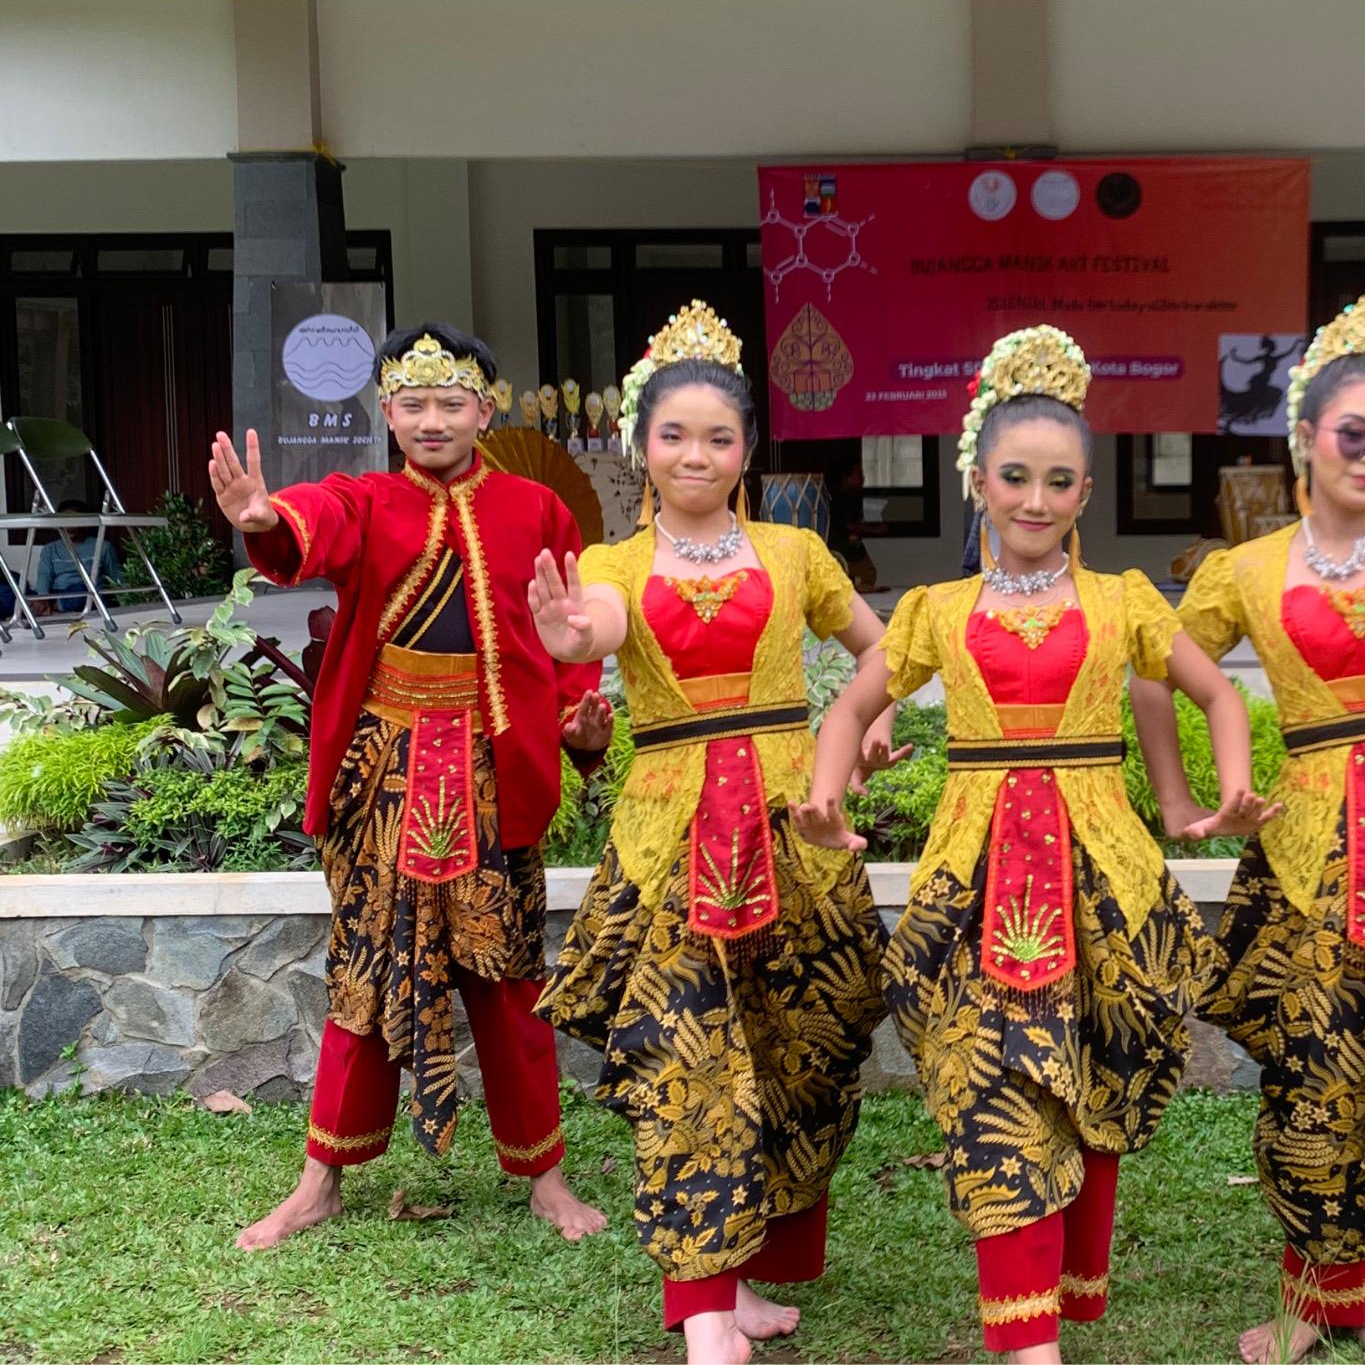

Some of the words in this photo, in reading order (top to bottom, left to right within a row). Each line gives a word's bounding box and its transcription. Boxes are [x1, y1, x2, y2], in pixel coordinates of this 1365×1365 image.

[1057, 256, 1089, 273] ART
[1090, 255, 1170, 273] FESTIVAL
[898, 362, 960, 381] Tingkat
[1091, 361, 1127, 376] Kota
[1129, 361, 1180, 379] Bogor
[879, 390, 925, 401] FEBRUARI
[320, 435, 350, 445] MANIK
